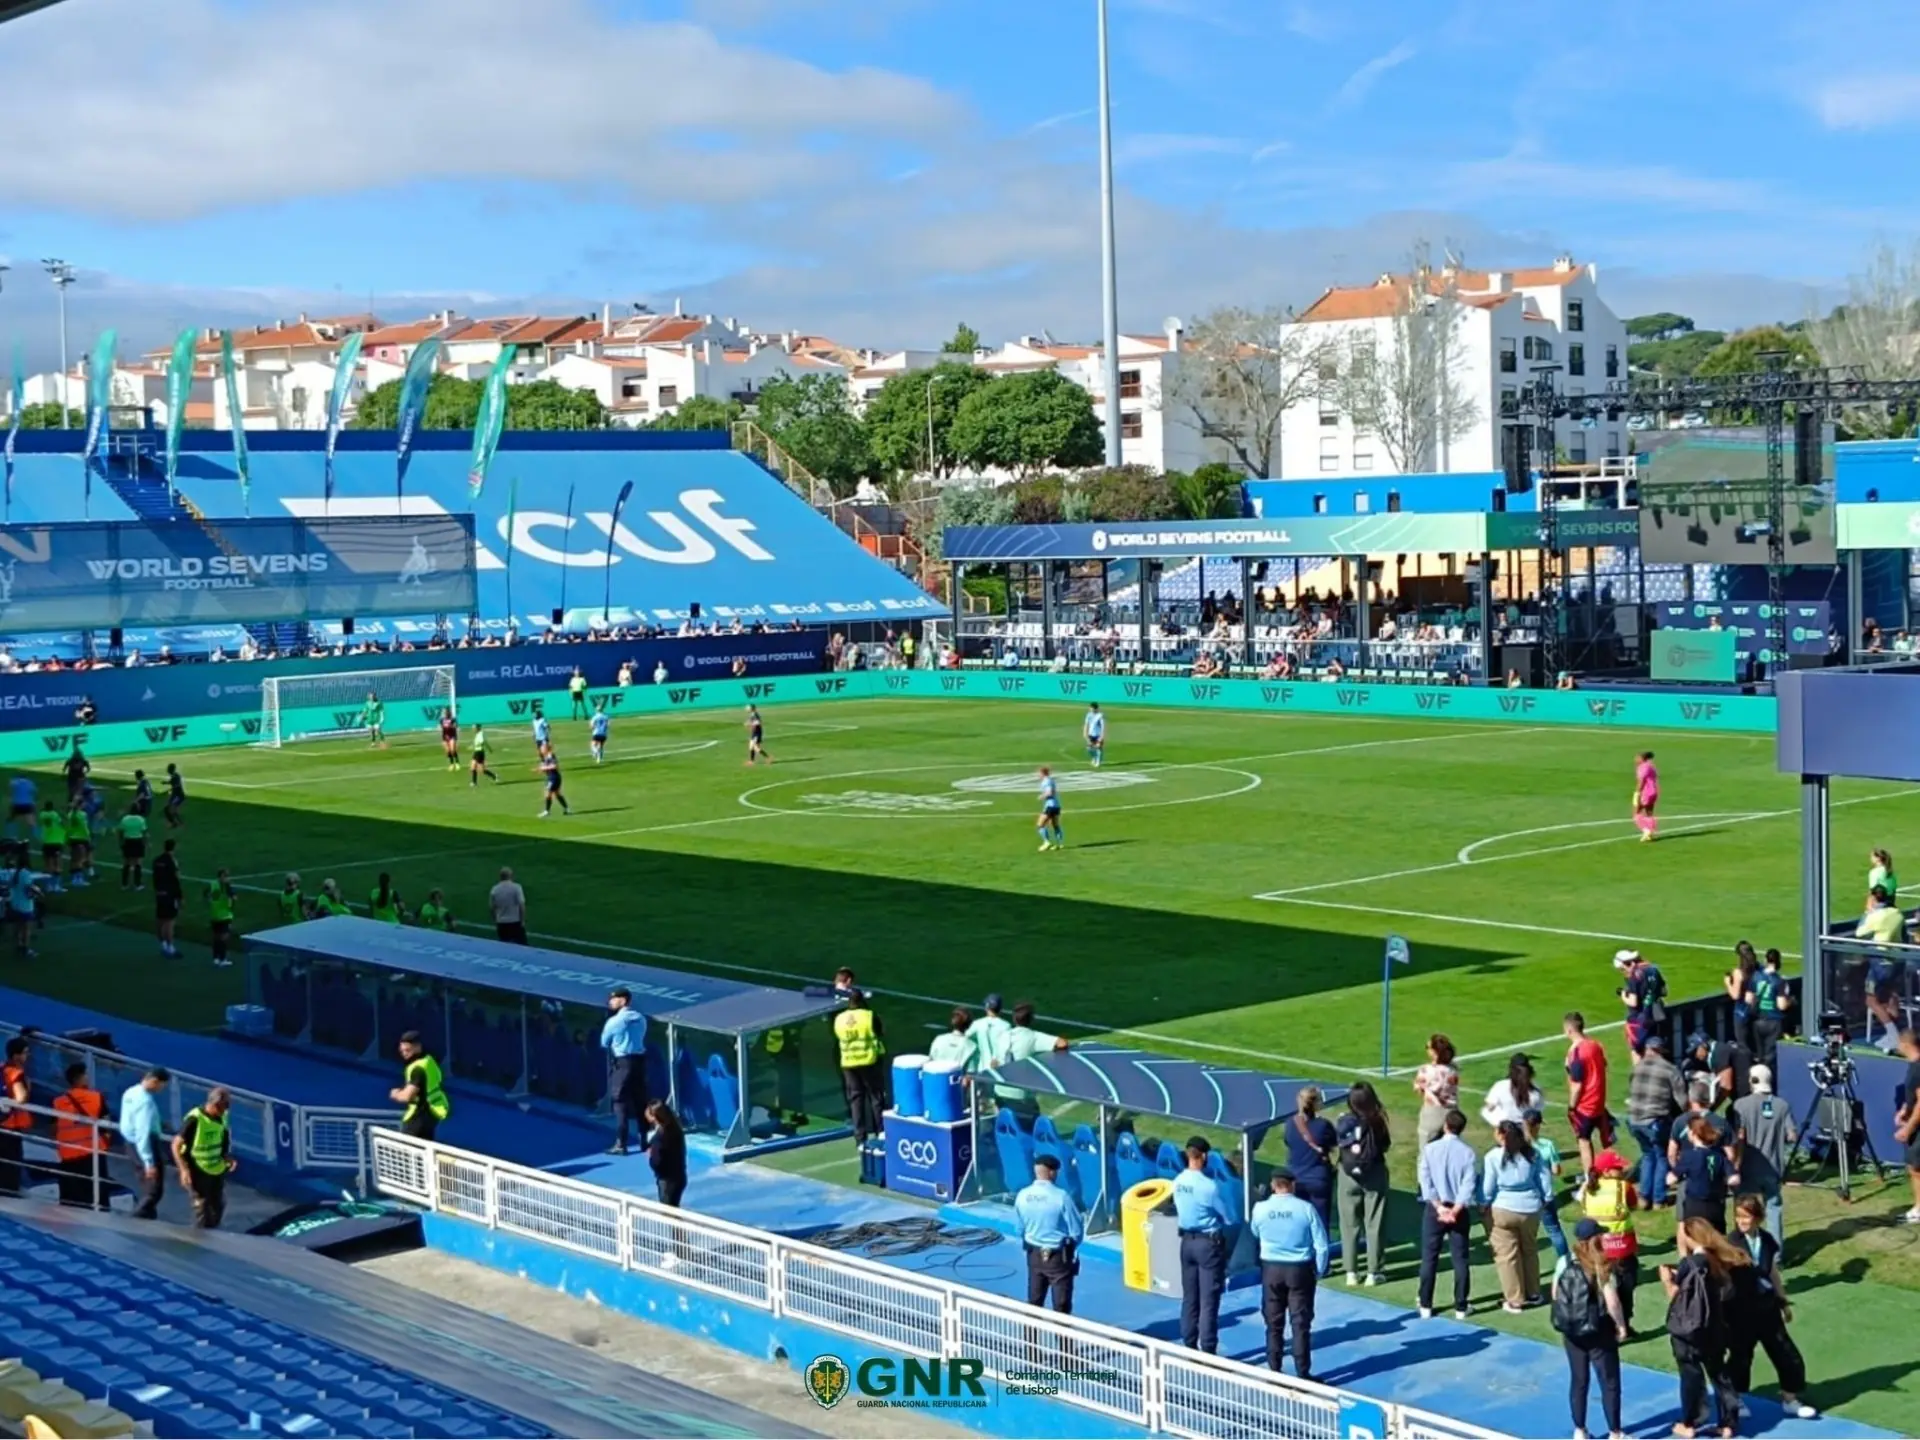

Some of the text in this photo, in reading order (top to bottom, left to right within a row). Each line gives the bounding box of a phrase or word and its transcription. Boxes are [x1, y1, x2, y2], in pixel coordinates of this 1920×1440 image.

[1109, 530, 1291, 546] WORLD SEVENS FOOTBALL
[86, 553, 328, 579] WORLD SEVENS
[164, 576, 255, 590] FOOTBALL
[500, 665, 543, 678] REAL
[278, 1121, 291, 1147] C
[897, 1138, 937, 1166] eco
